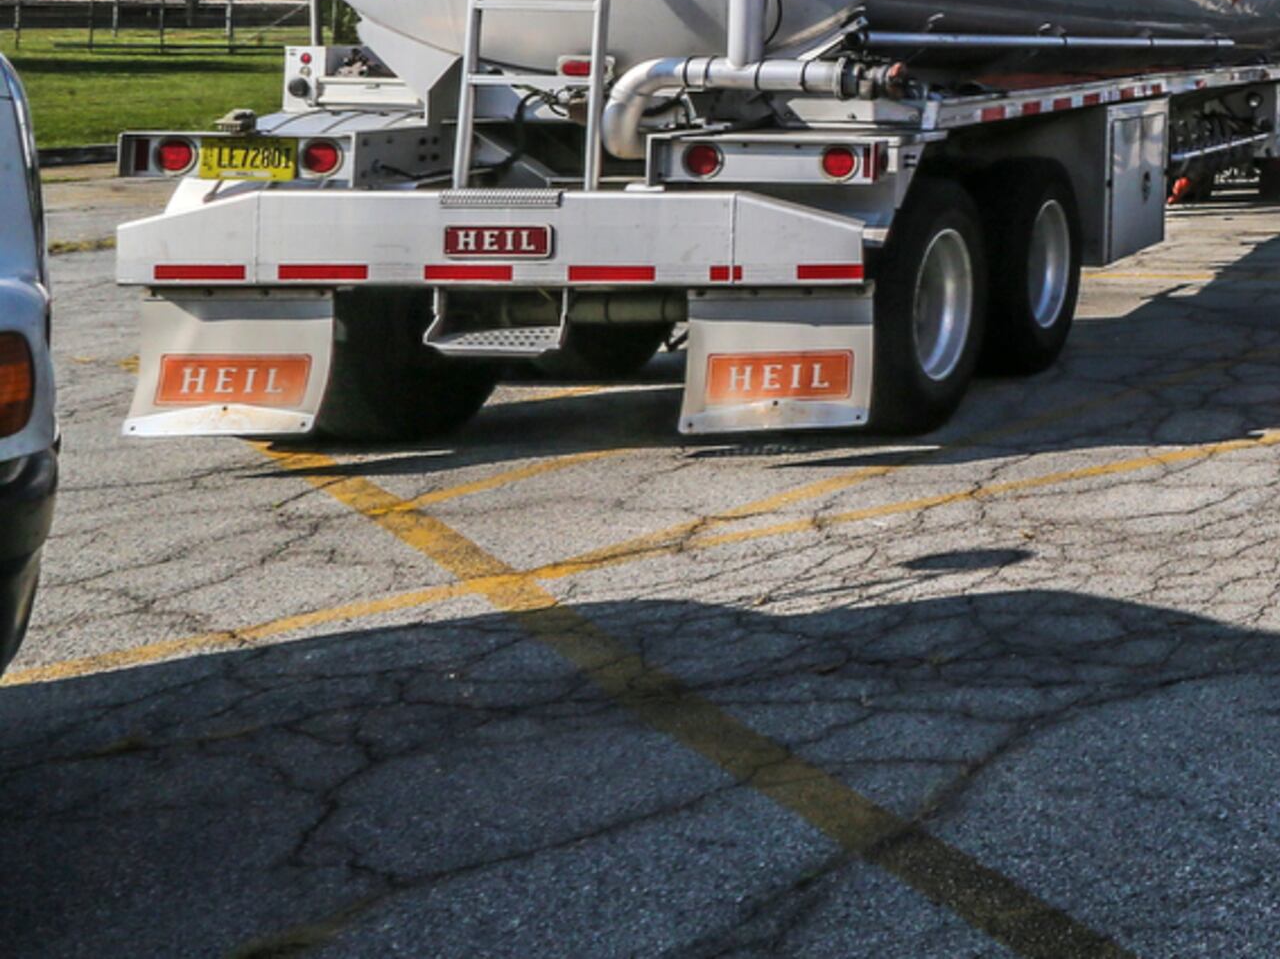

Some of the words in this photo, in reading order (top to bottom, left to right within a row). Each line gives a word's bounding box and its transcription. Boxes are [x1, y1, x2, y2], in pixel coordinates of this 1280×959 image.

[456, 230, 536, 251] HEIL
[180, 367, 284, 393] HEIL
[727, 362, 830, 392] HEIL
